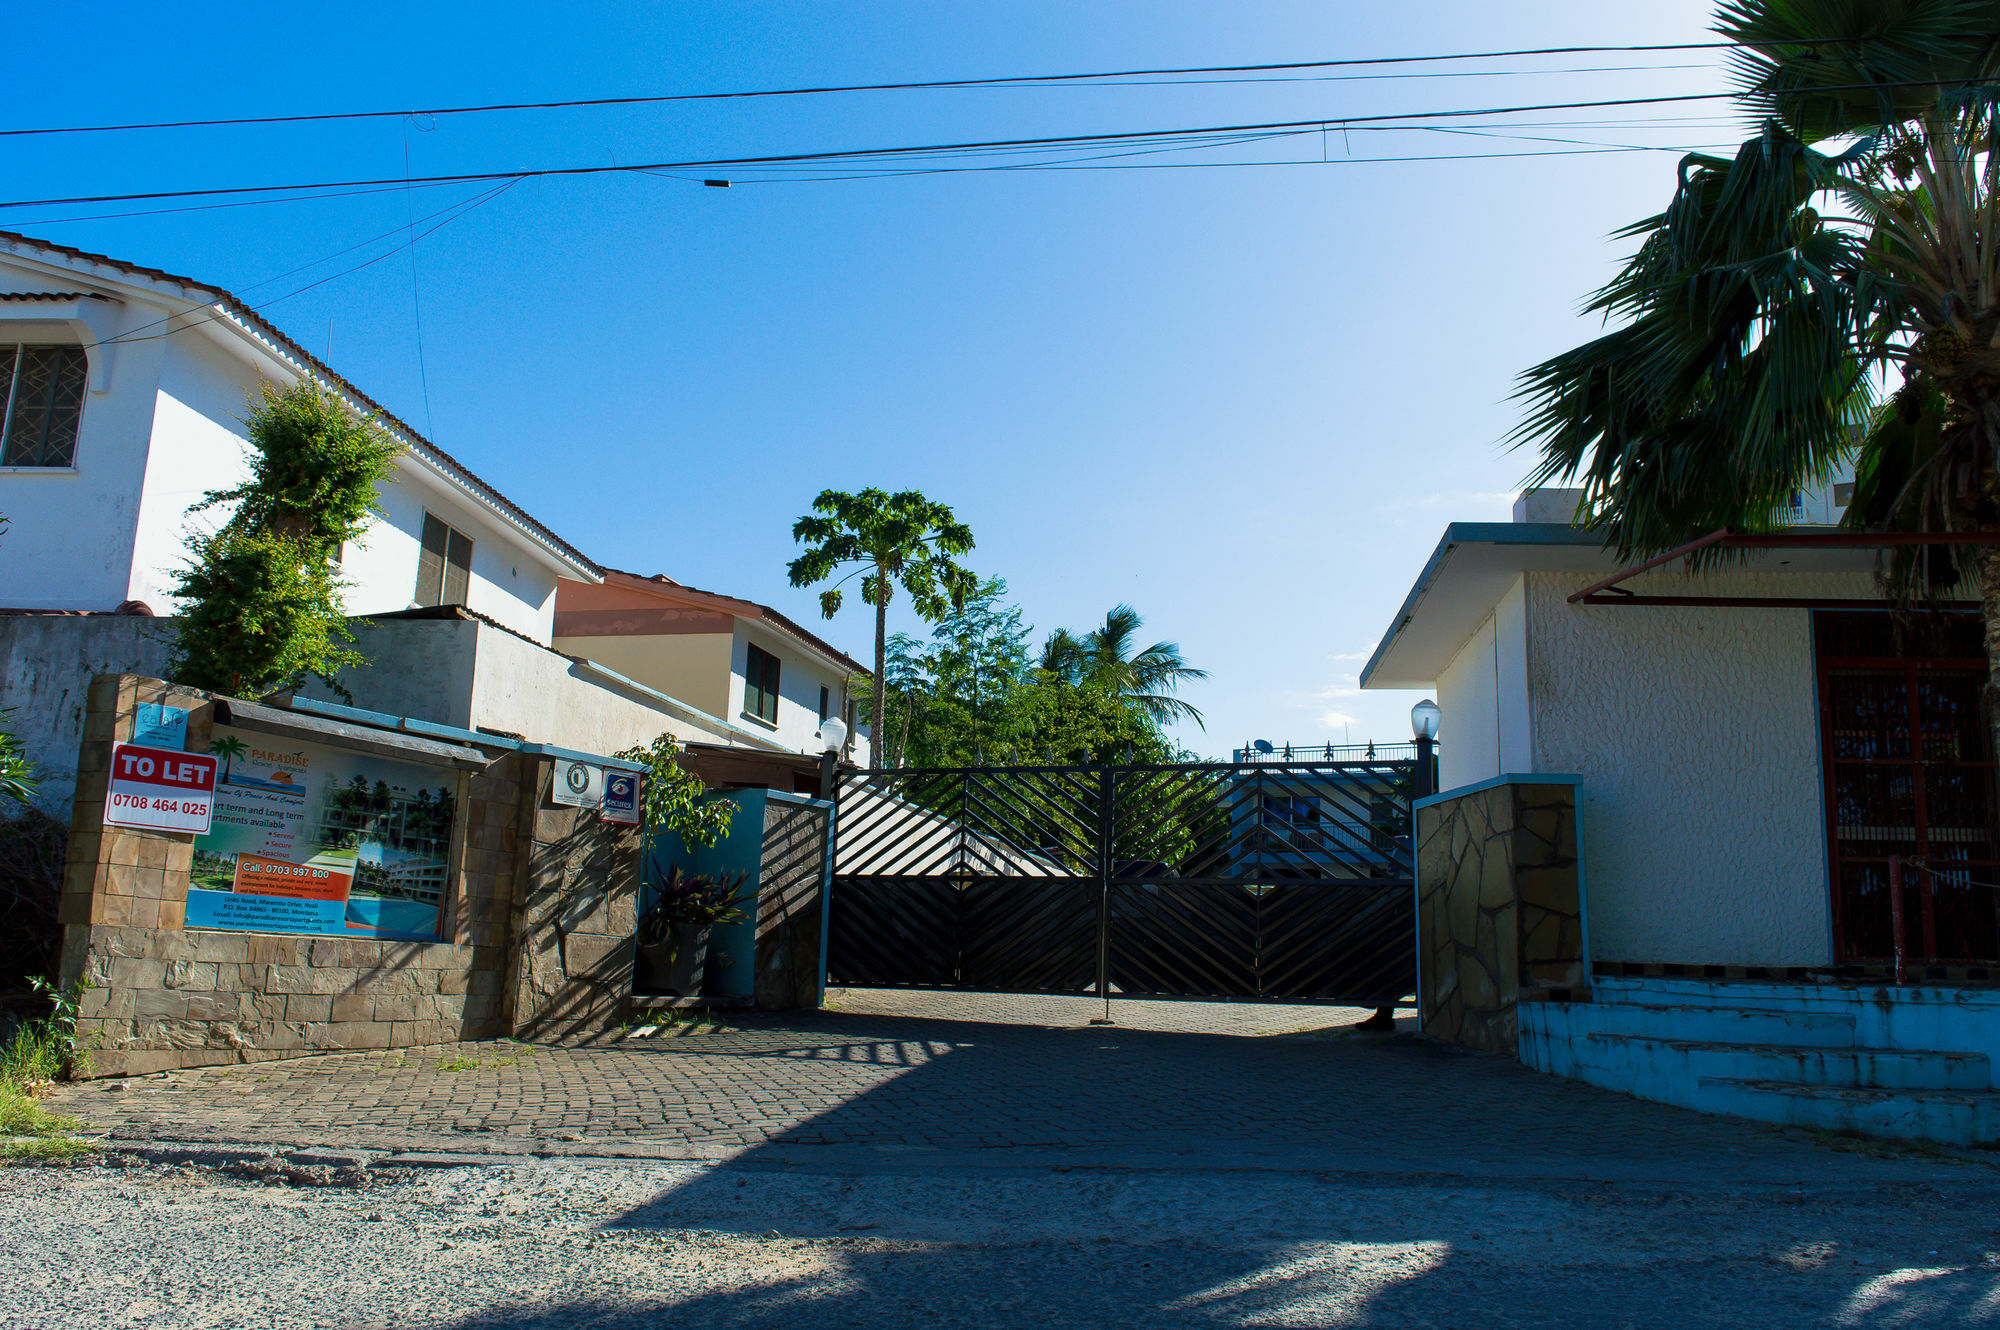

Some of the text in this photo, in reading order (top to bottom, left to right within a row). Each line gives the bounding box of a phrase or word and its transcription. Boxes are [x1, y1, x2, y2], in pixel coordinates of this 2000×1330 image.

[251, 749, 309, 767] PARADISE
[121, 754, 210, 784] TO LET
[114, 793, 207, 816] 0708 464 025
[607, 799, 632, 809] securex
[214, 802, 224, 811] ort
[227, 803, 246, 813] term
[248, 807, 263, 816] and
[286, 811, 304, 821] term
[250, 818, 286, 830] available
[271, 841, 292, 849] Secure
[262, 850, 290, 858] Spacious
[243, 862, 329, 879] Call: 0703 997 800
[292, 908, 318, 917] Mombasa
